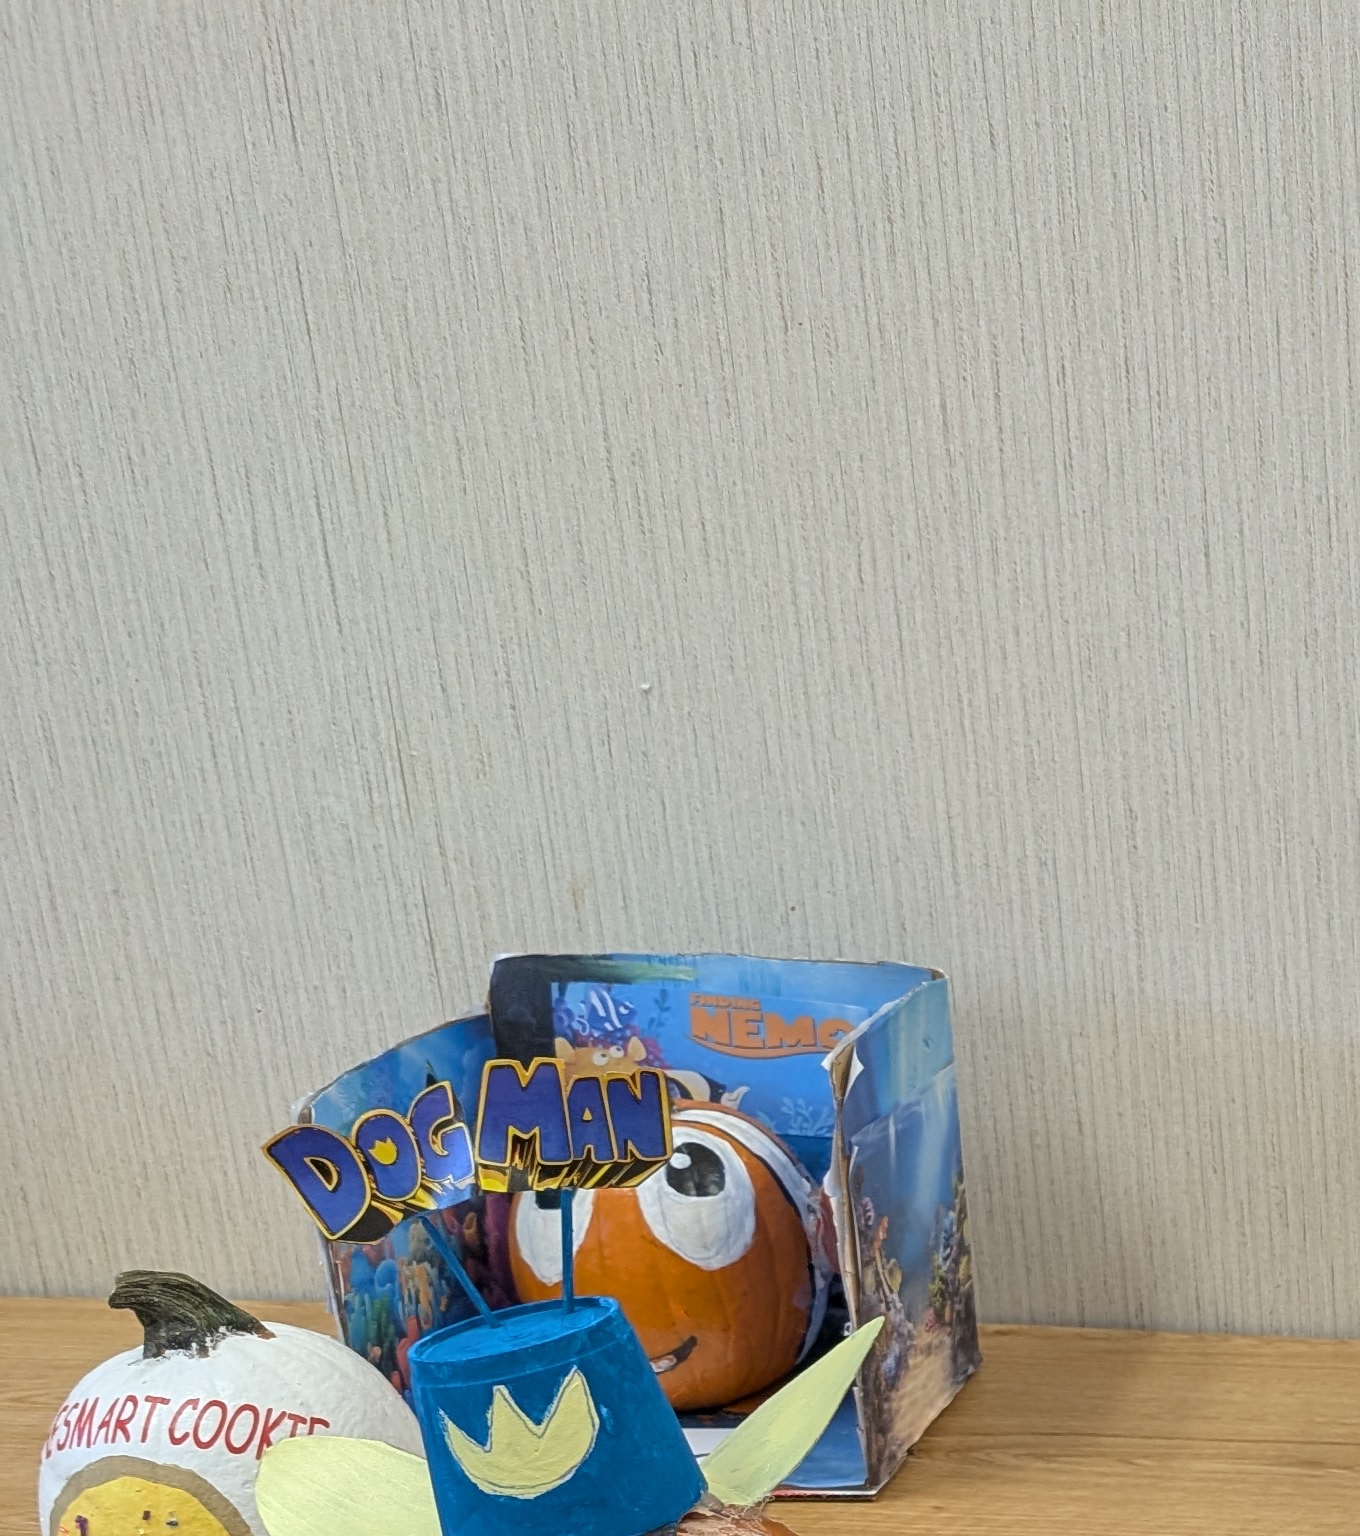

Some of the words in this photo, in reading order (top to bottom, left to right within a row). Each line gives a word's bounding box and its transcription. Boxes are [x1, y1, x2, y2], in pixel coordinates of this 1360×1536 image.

[689, 992, 762, 1011] FINDING
[690, 1006, 856, 1050] NEMO
[262, 1081, 475, 1244] DOG
[475, 1057, 673, 1192] MAN
[56, 1395, 172, 1451] SMART
